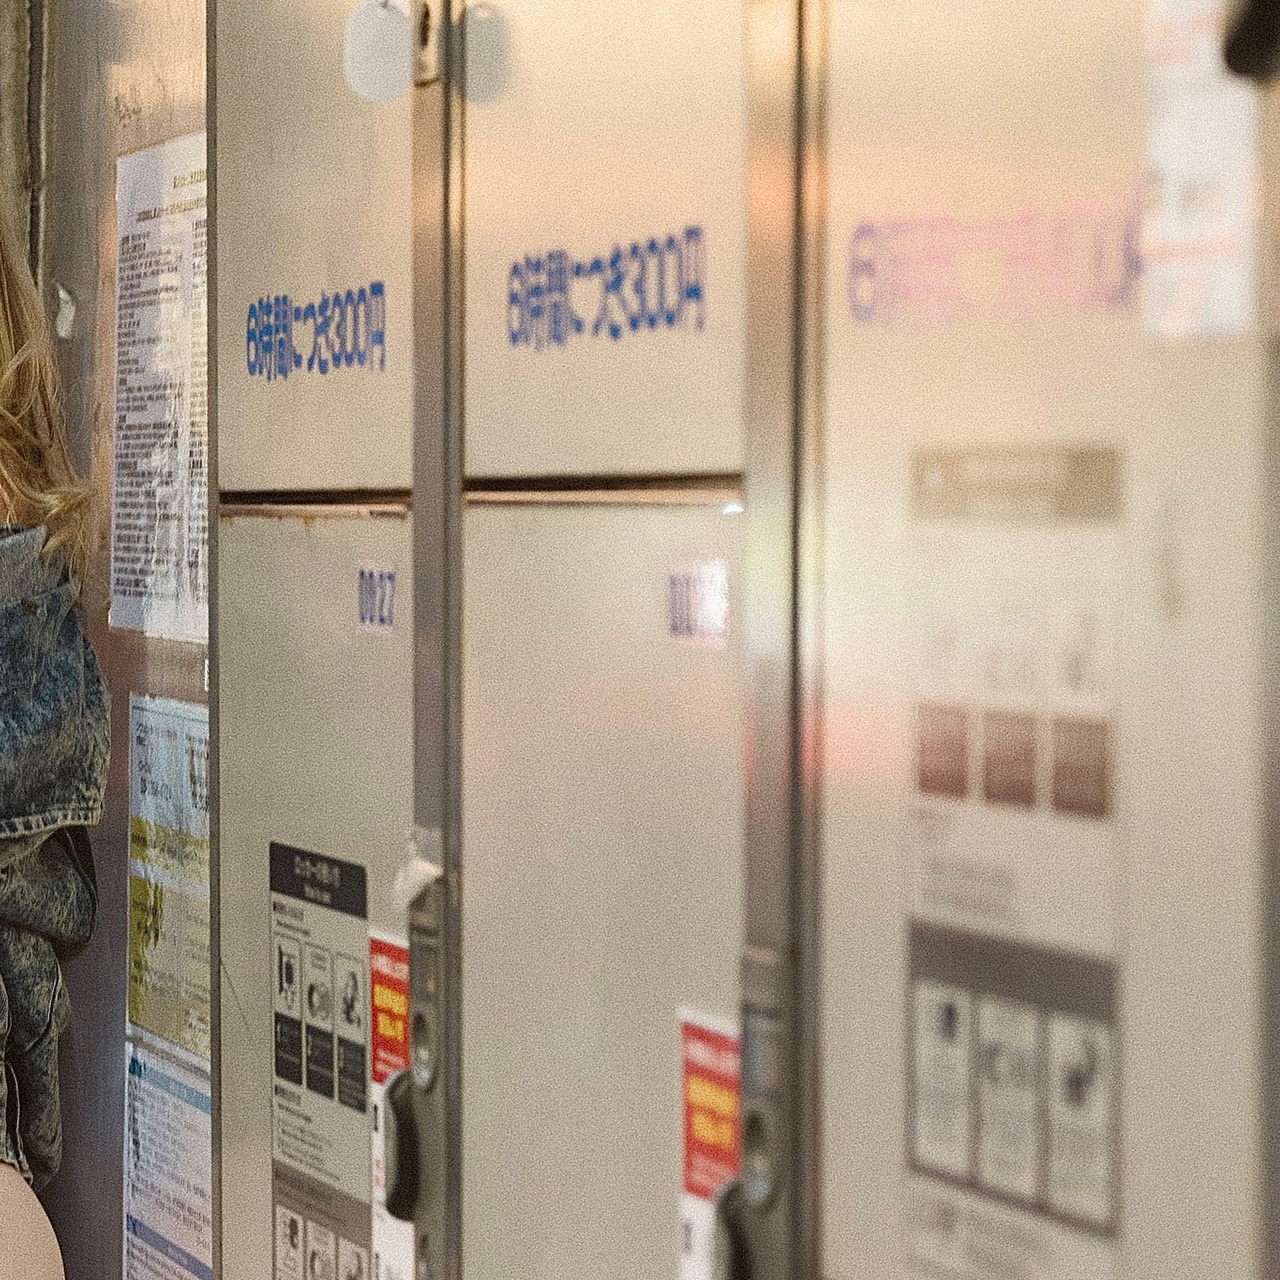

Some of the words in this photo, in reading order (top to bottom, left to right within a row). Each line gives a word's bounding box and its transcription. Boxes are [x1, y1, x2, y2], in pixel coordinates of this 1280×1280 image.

[246, 280, 385, 382] 6時間につき300円
